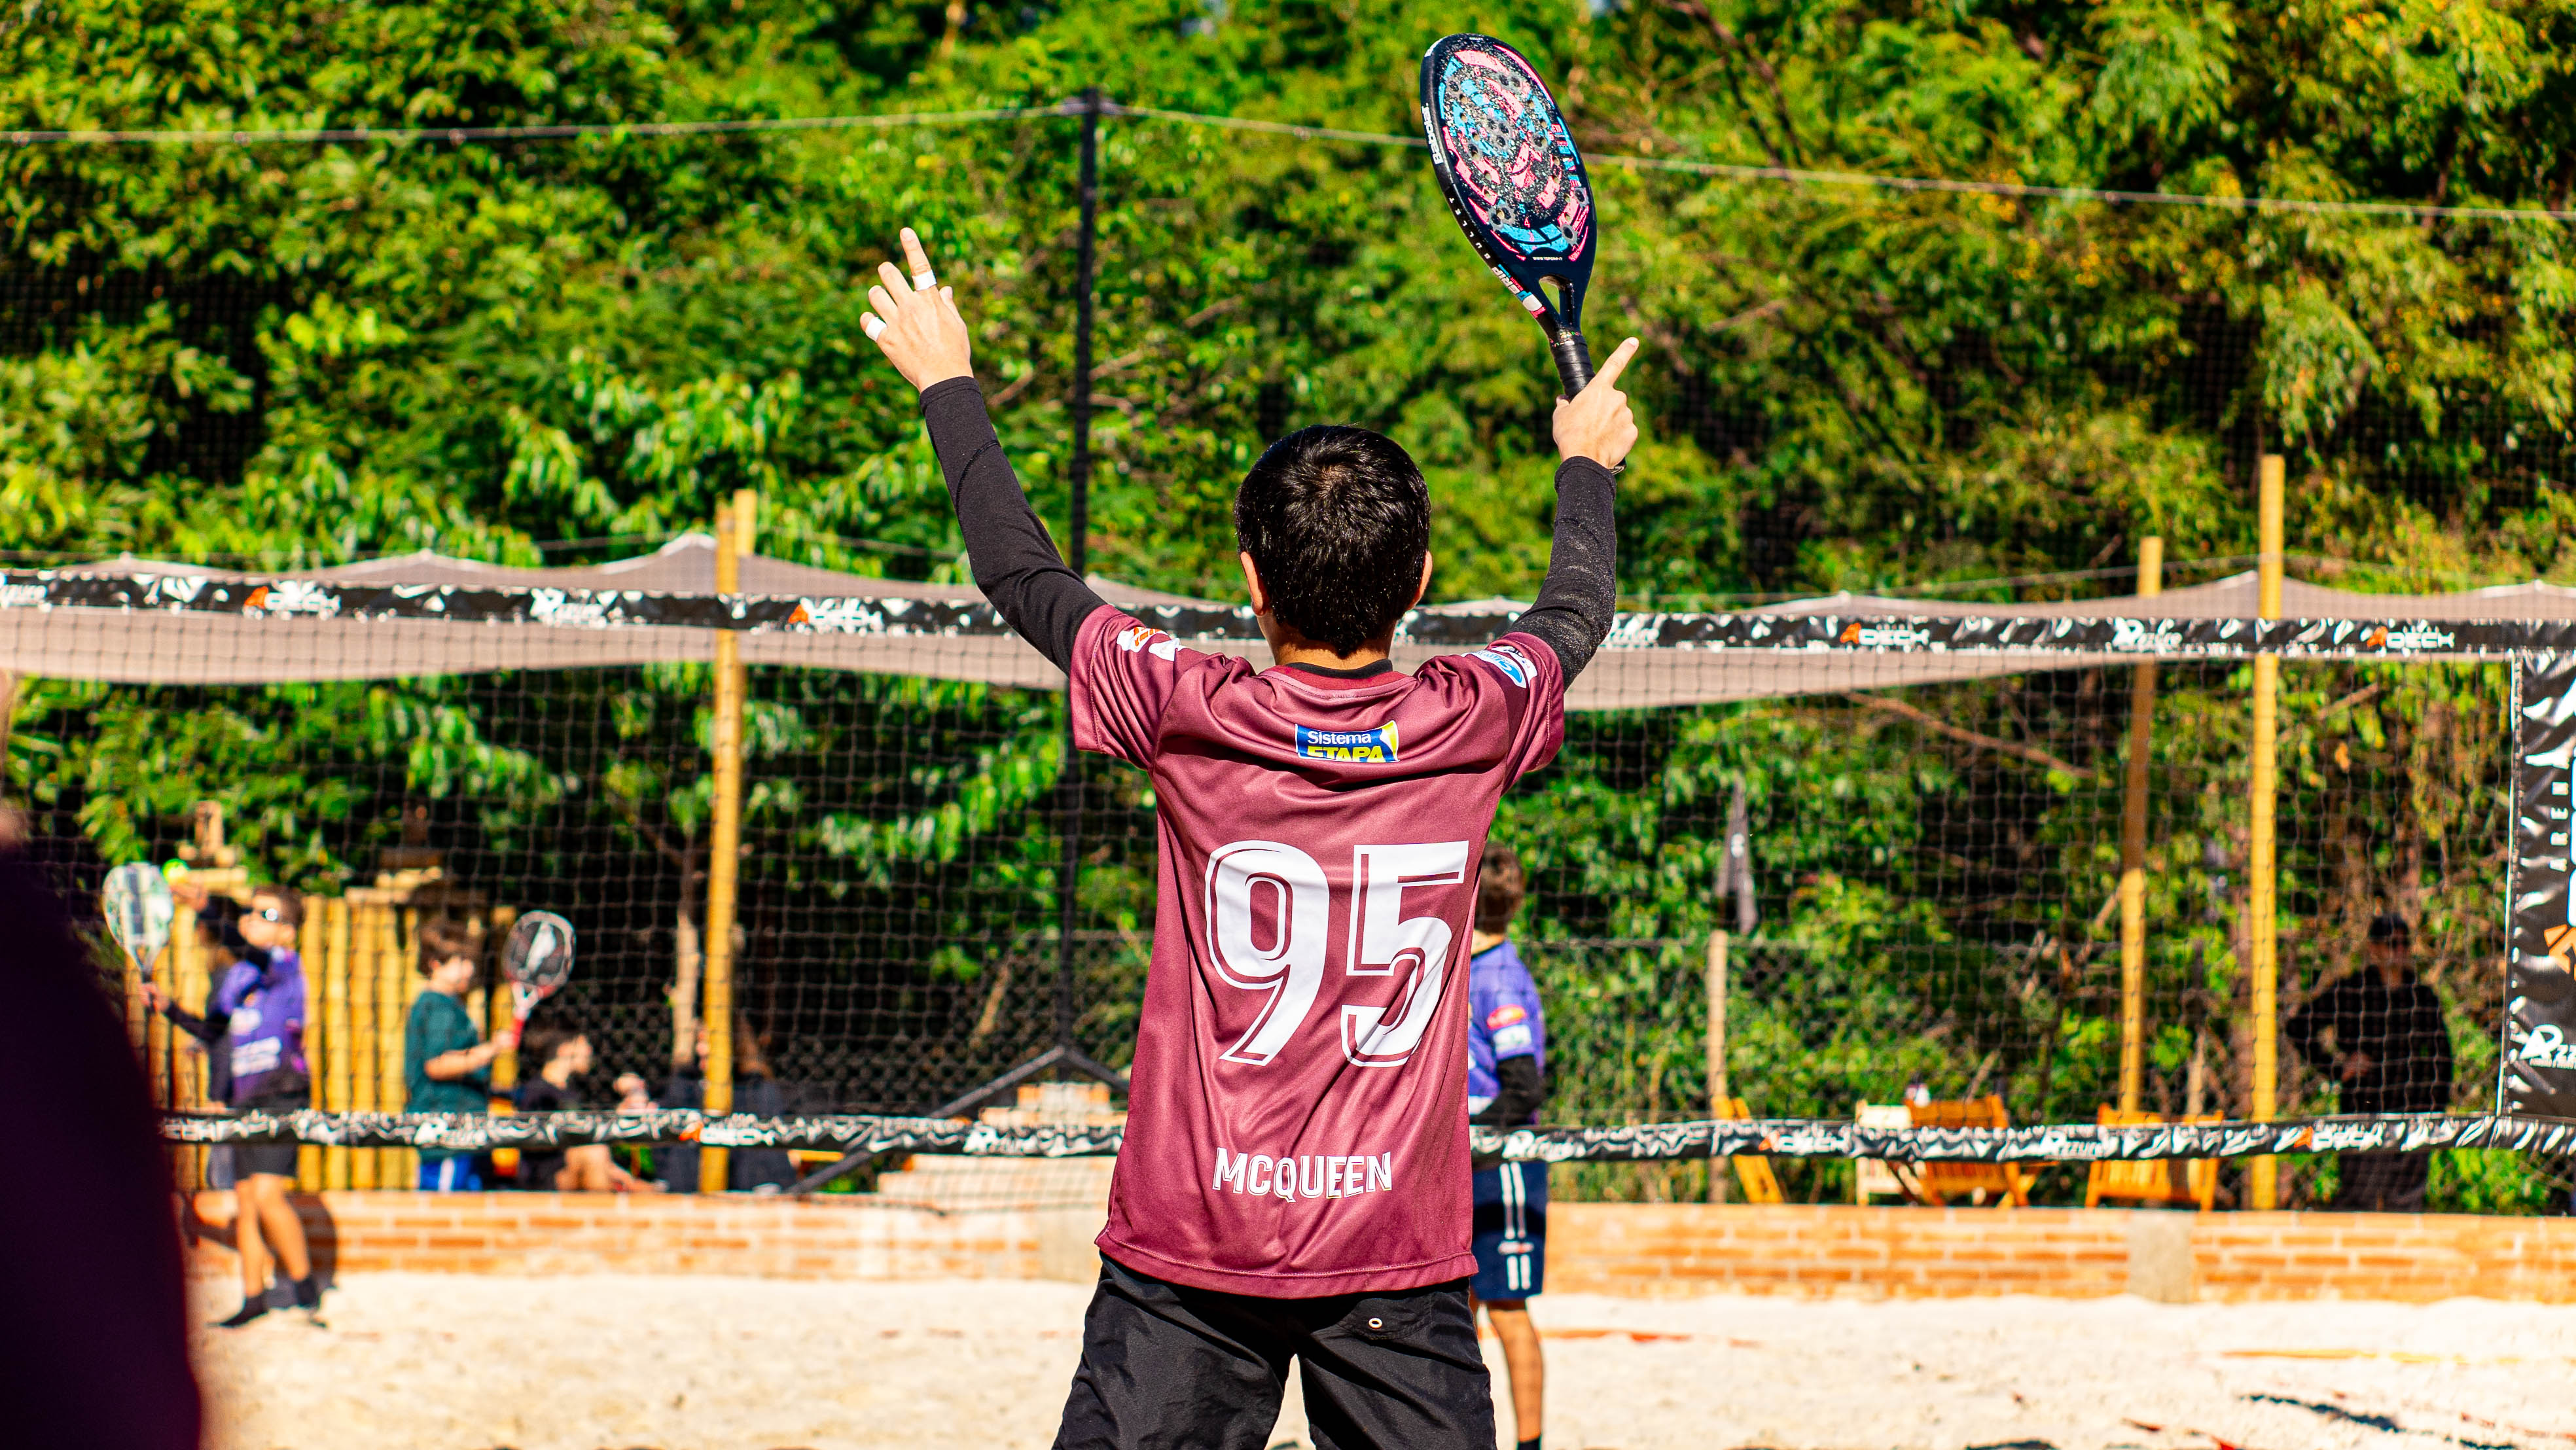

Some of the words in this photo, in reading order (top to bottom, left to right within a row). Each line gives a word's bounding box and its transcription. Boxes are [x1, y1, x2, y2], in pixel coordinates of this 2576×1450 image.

[1448, 197, 1492, 260] BULLET
[1491, 266, 1520, 294] GRIP
[1307, 745, 1387, 762] ETAPA
[1308, 730, 1372, 745] Sistema
[1205, 840, 1469, 1068] 95
[1212, 1147, 1392, 1203] MCQUEEN
